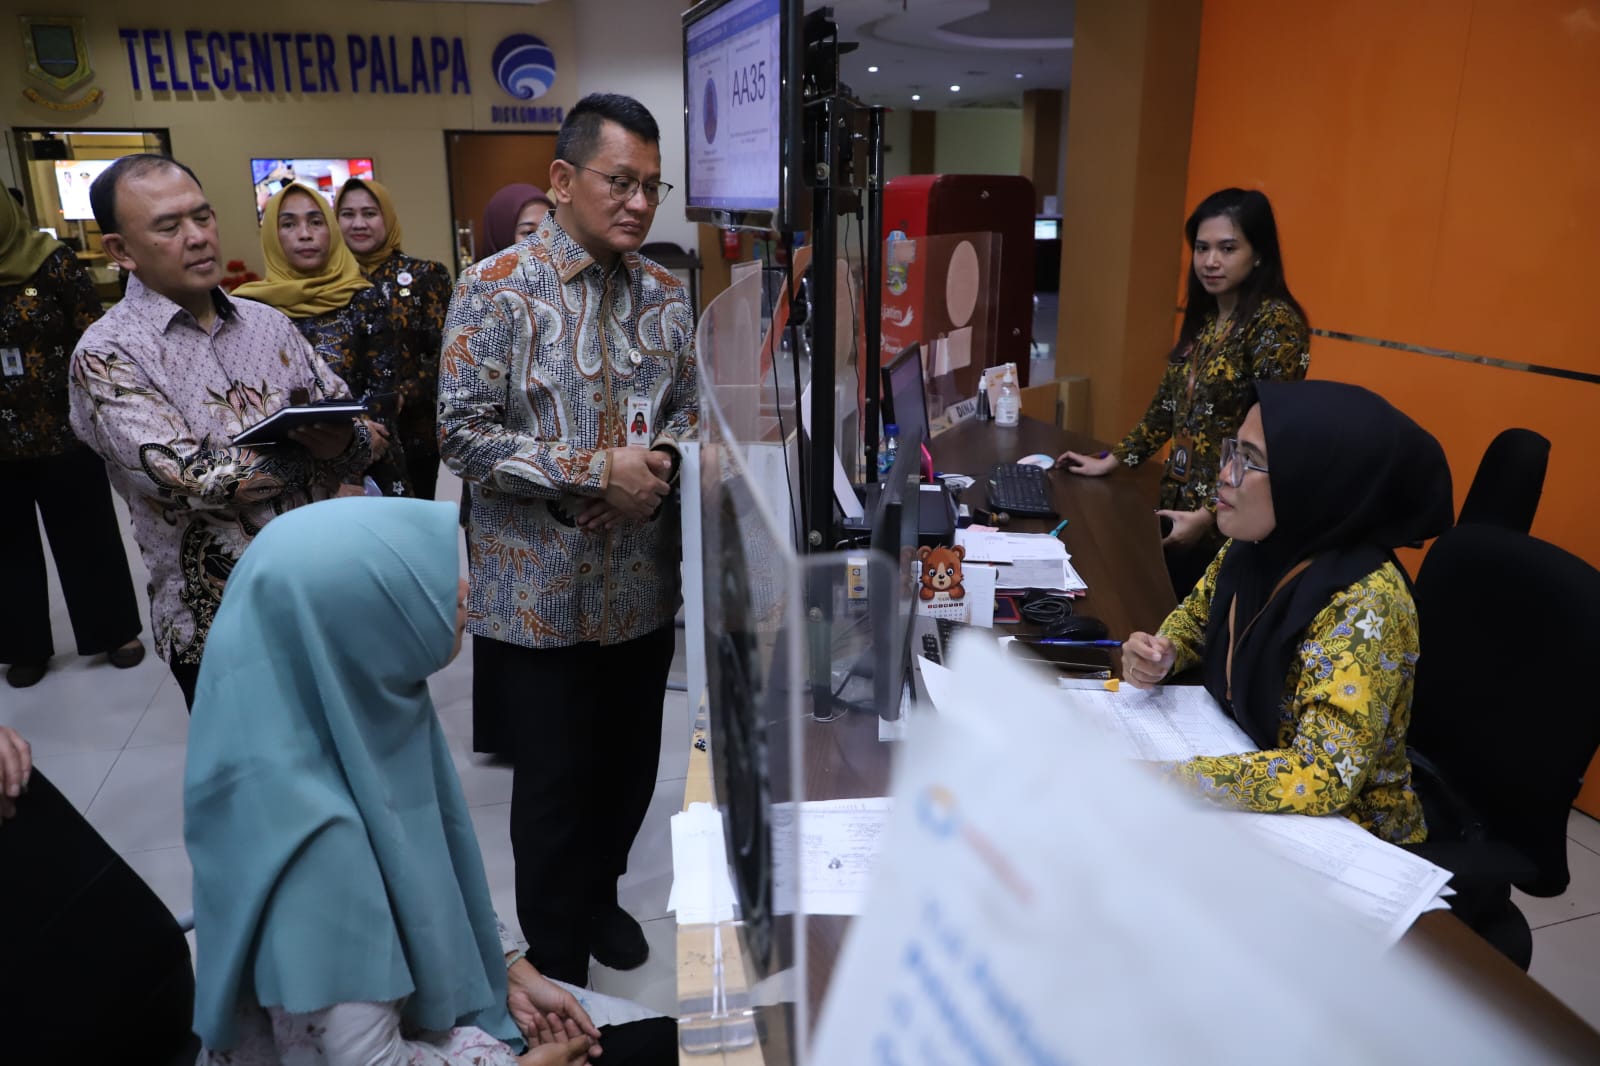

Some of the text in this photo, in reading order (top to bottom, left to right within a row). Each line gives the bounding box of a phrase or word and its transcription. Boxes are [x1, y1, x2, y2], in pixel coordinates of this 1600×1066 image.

[119, 29, 472, 95] TELECENTER PALAPA
[732, 60, 767, 107] AA35
